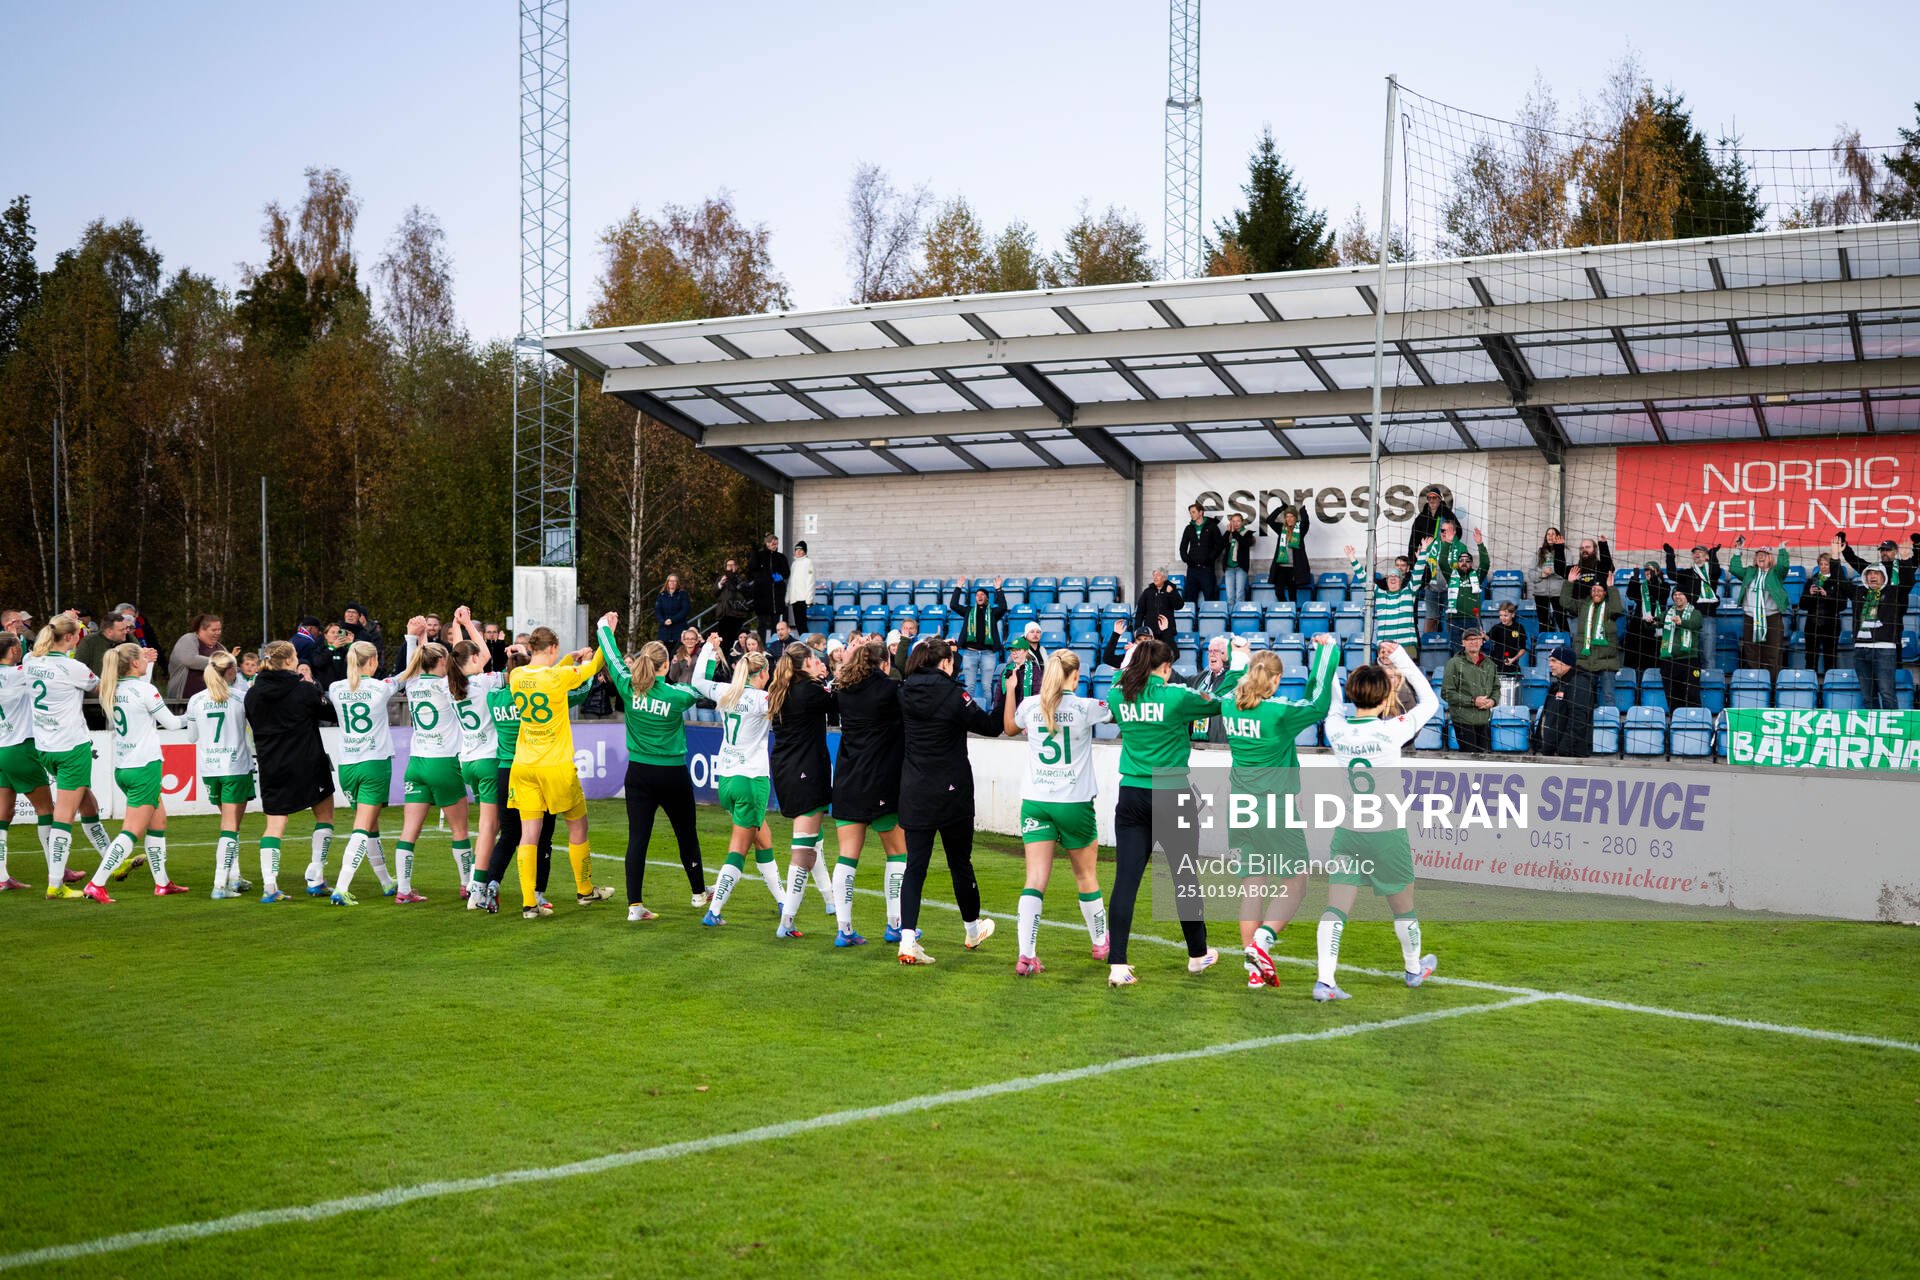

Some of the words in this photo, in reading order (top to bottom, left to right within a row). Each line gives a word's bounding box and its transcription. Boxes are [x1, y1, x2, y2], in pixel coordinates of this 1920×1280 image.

[1703, 456, 1900, 494] NORDIC
[1655, 495, 1920, 533] WELLNES
[32, 680, 49, 711] 2
[112, 695, 129, 704] NDAL
[338, 691, 372, 701] CARLSSON
[513, 691, 553, 723] 28
[631, 695, 672, 717] BAJEN
[113, 705, 128, 737] 9
[206, 711, 226, 743] 7
[341, 702, 373, 734] 18
[410, 701, 439, 731] 10
[451, 699, 481, 731] 15
[493, 705, 520, 722] BAJE
[1033, 712, 1074, 723] HOBERG
[1119, 702, 1165, 722] BAJEN
[1223, 716, 1261, 739] BAJEN
[723, 711, 742, 746] 17
[1037, 726, 1072, 765] 31
[1347, 757, 1376, 795] 6
[1537, 775, 1711, 831] SERVICE
[1530, 830, 1571, 850] 0451
[1601, 835, 1637, 856] 280
[1649, 839, 1674, 859] 63
[1410, 848, 1484, 872] räbidar
[1490, 857, 1508, 874] te
